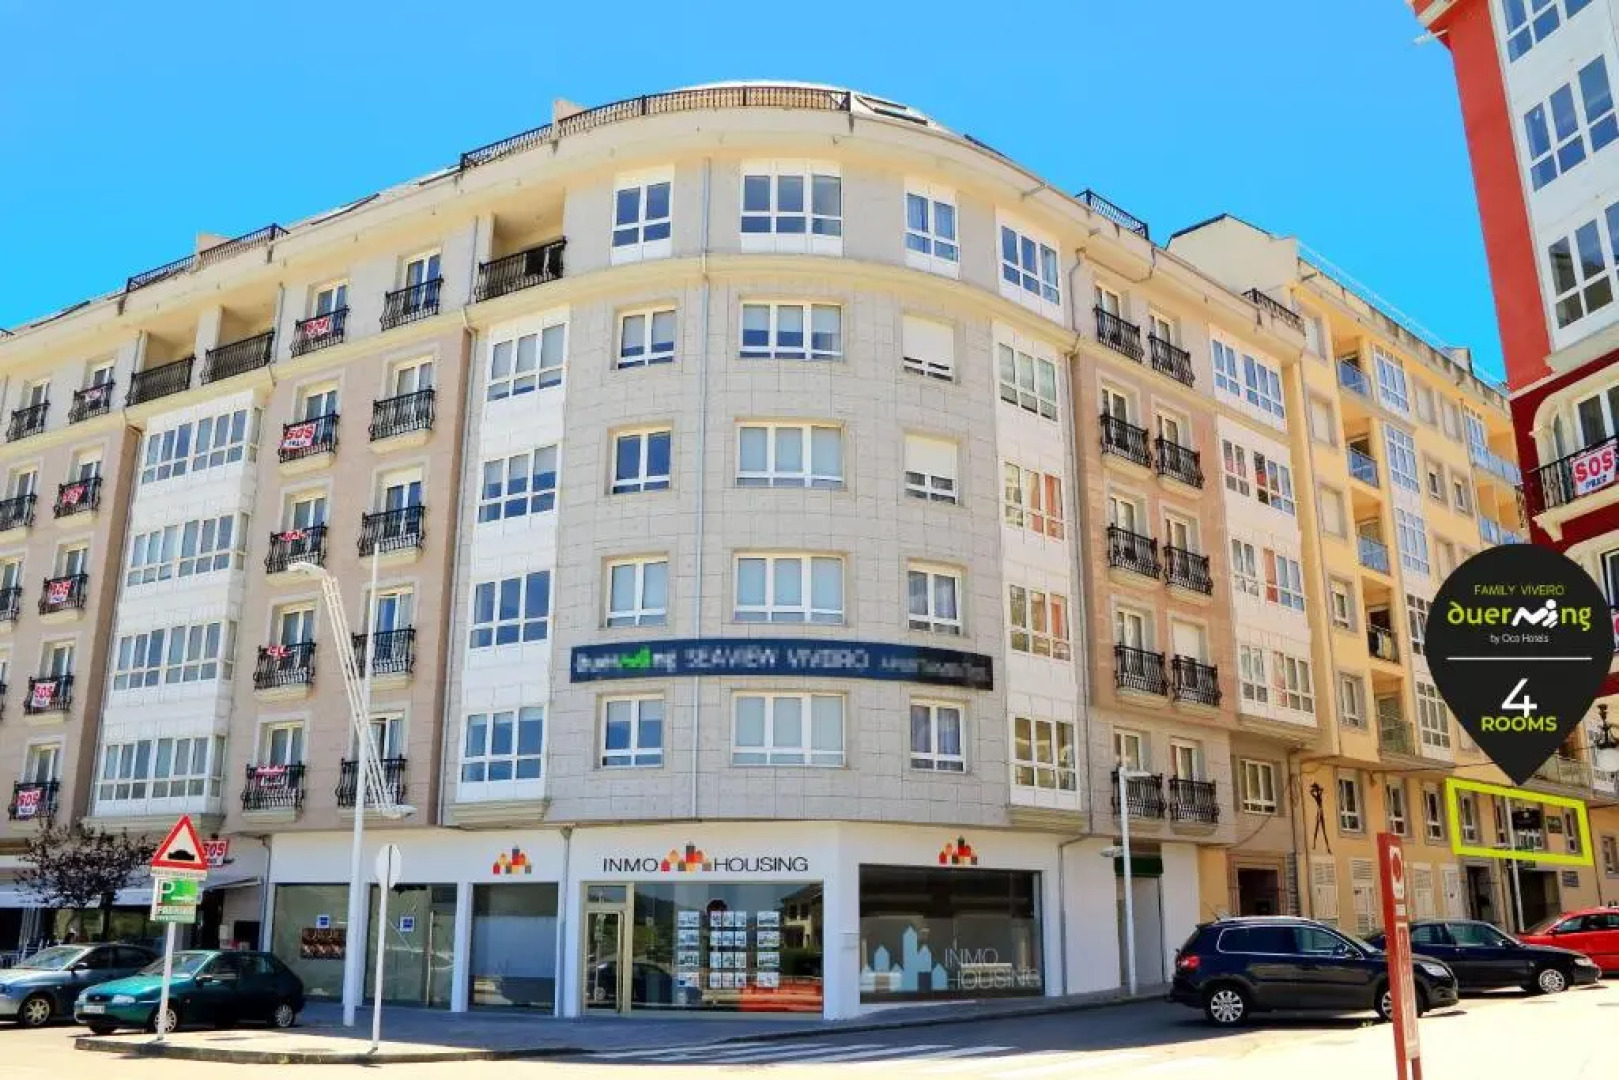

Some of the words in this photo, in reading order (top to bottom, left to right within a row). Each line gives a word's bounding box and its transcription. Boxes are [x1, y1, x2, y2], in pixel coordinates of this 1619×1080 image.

[286, 427, 314, 440] SOS
[1575, 450, 1613, 482] SOS
[603, 857, 659, 873] INMO
[714, 856, 809, 873] HOUSING
[944, 948, 999, 968] INMO
